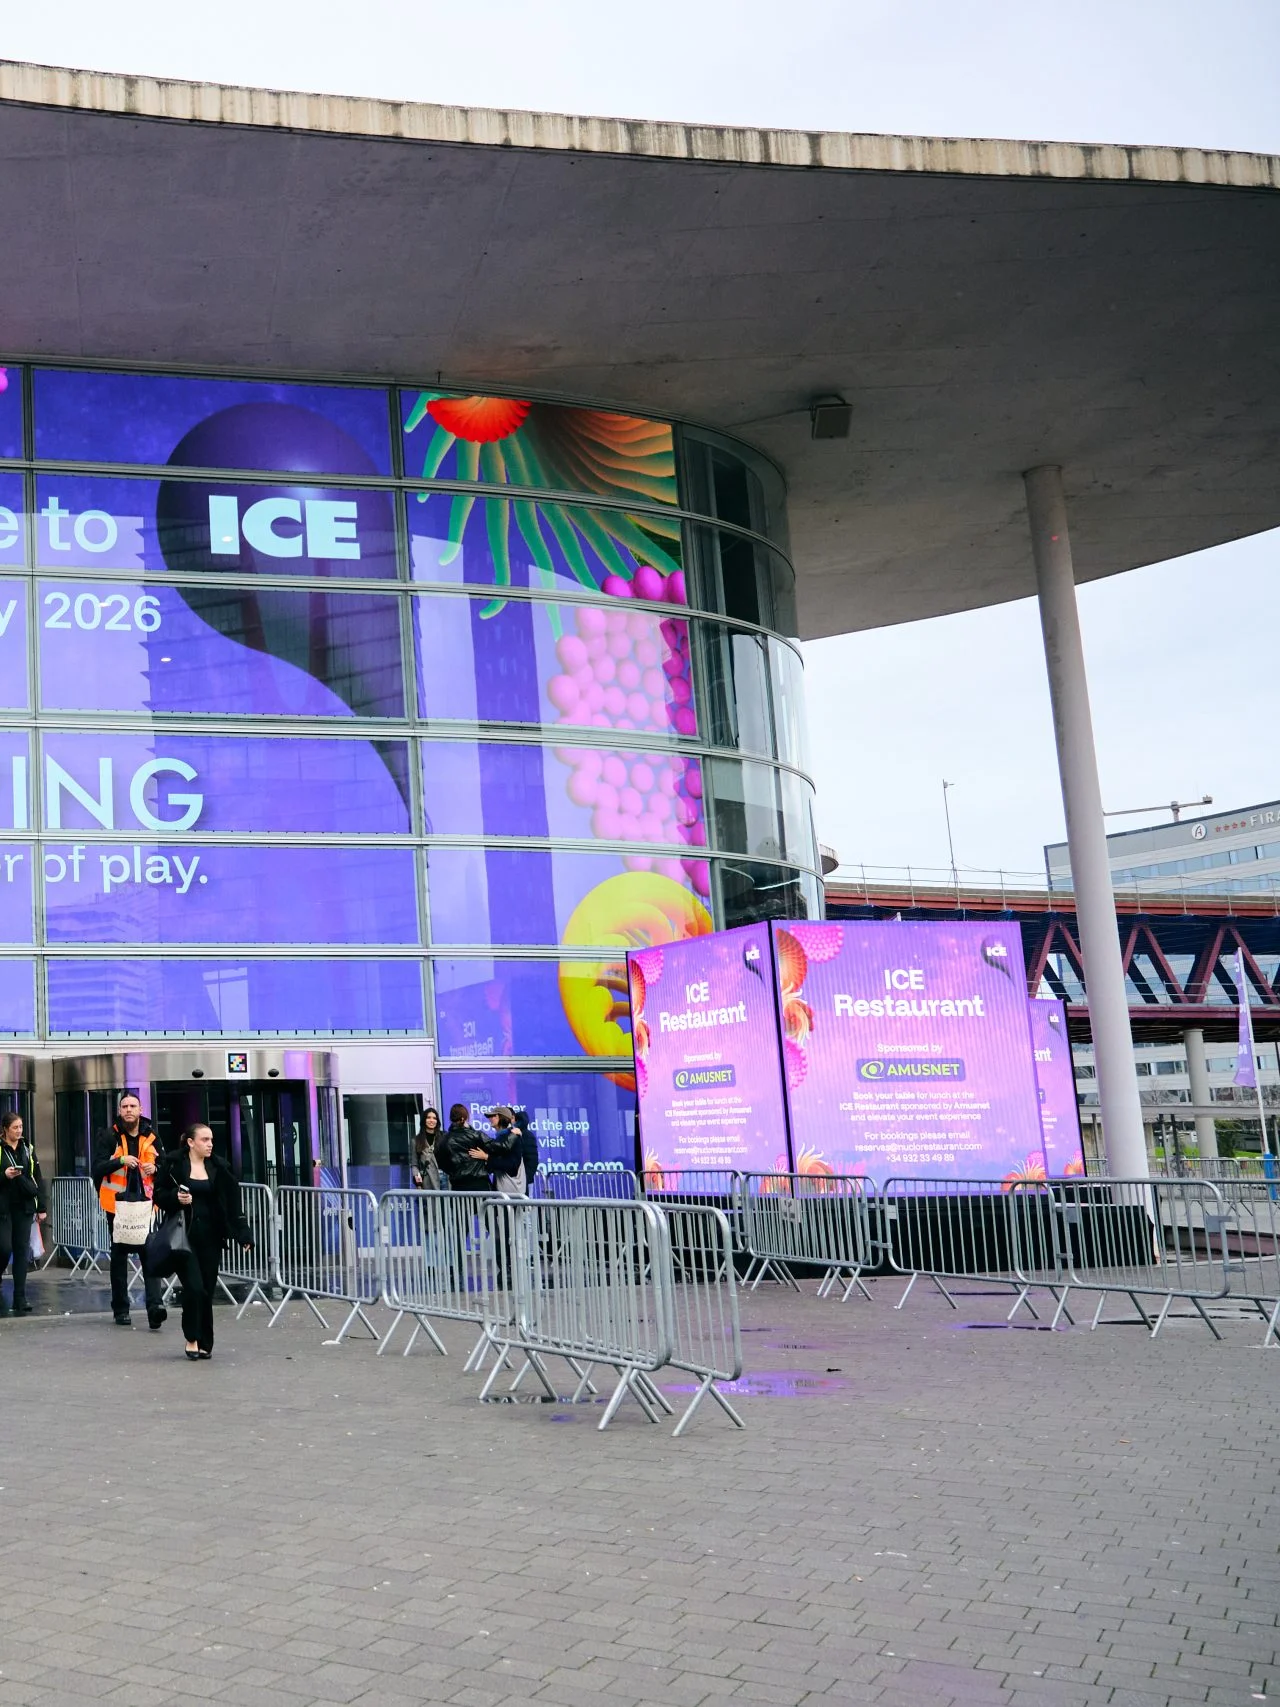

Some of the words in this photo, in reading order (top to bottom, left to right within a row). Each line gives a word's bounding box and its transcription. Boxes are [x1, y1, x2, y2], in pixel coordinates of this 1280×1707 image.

[43, 497, 118, 554] to
[208, 494, 361, 560] ICE
[44, 591, 162, 633] 2026
[44, 845, 86, 883] of
[100, 846, 209, 894] play.
[986, 947, 1007, 956] ICE
[884, 969, 924, 990] ICE
[685, 981, 710, 1004] ICE
[833, 993, 985, 1017] Restaurant
[660, 1000, 747, 1032] Restaurant
[877, 1043, 928, 1054] Sponsored
[931, 1043, 943, 1054] by
[690, 1069, 732, 1084] AMUSNET
[887, 1064, 960, 1076] AMUSNET
[542, 1120, 563, 1131] the
[565, 1122, 590, 1133] app
[539, 1136, 565, 1148] visit
[886, 1154, 901, 1162] +34
[903, 1154, 918, 1162] 932
[920, 1153, 930, 1162] 33
[932, 1153, 942, 1161] 49
[944, 1153, 955, 1161] 89
